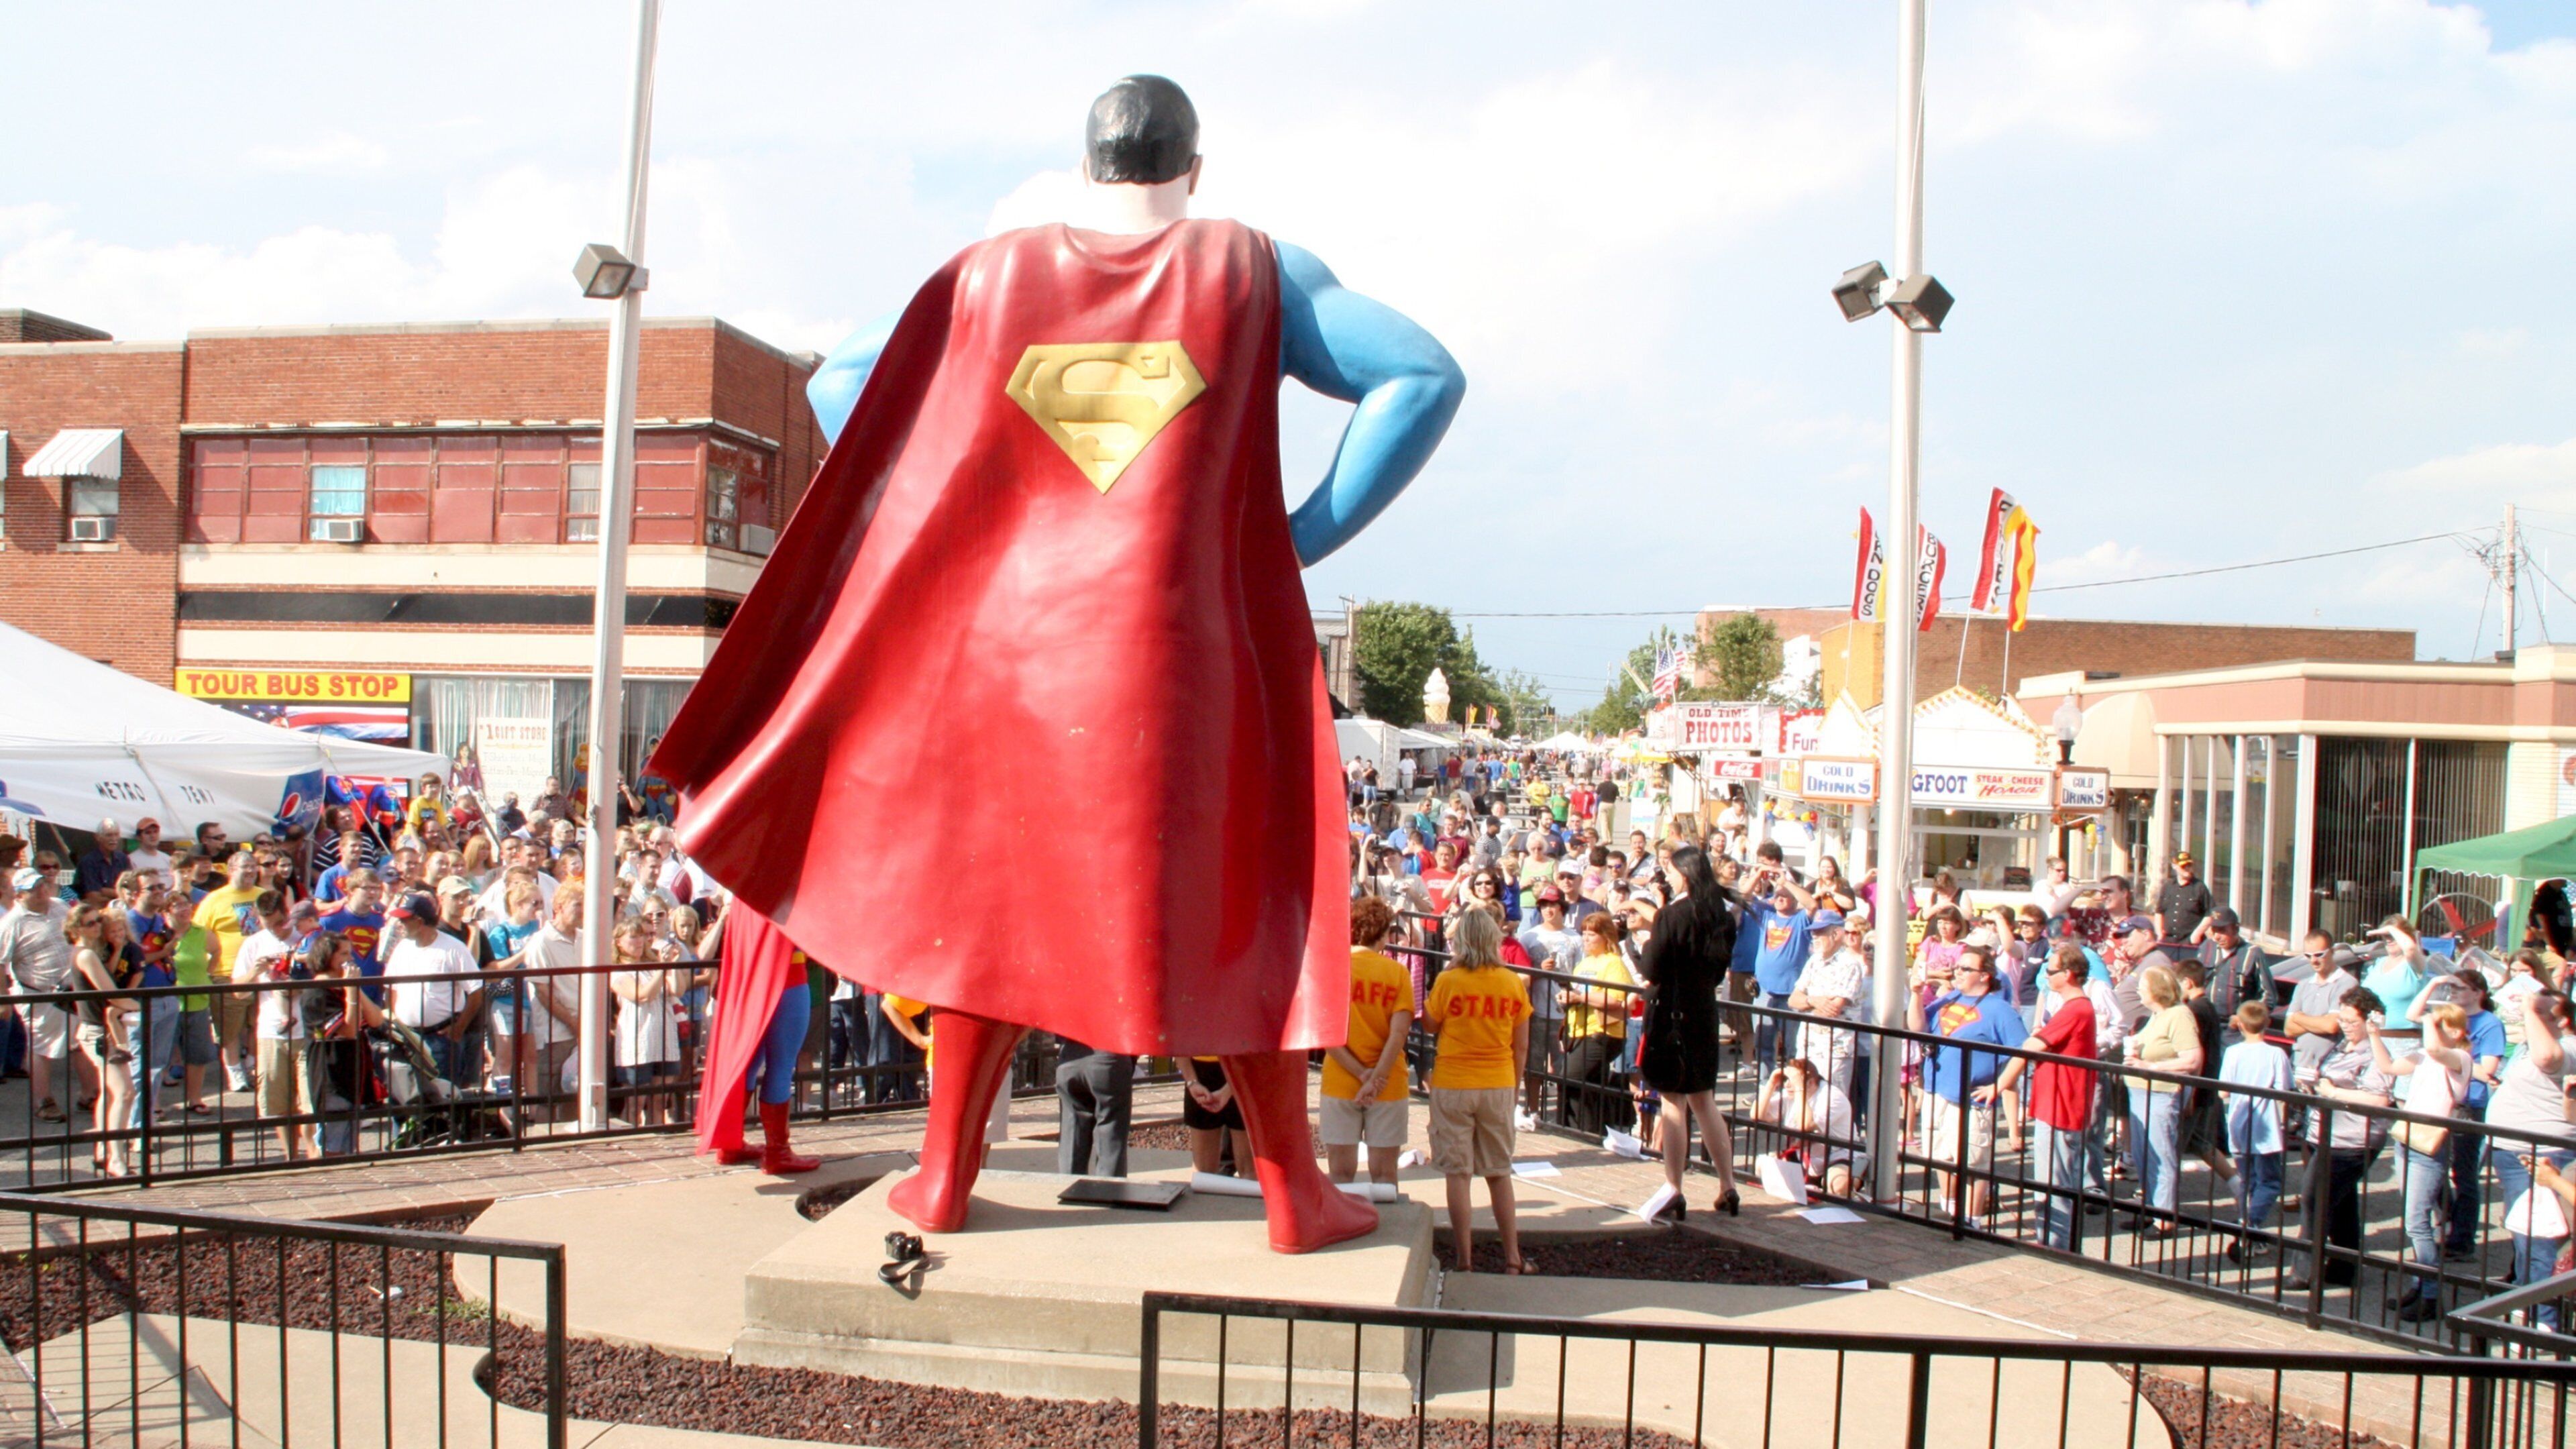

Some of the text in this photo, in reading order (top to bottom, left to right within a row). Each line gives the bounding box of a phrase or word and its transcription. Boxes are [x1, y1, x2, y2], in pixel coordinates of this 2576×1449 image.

[1917, 532, 1937, 623] BURGER
[1862, 569, 1880, 616] DOGS
[186, 674, 398, 697] TOUR BUS STOP
[1688, 708, 1711, 718] OLD
[1685, 721, 1752, 743] PHOTOS
[1823, 765, 1854, 777] COLD
[1976, 775, 2044, 786] STEAK CHEESE
[1807, 775, 1871, 795] DRINKS
[1912, 774, 1968, 794] GFOOT
[2072, 777, 2093, 788] COLD
[95, 782, 215, 805] METRO TENT
[2062, 790, 2104, 804] DRINKS
[1351, 980, 1398, 1008] AFF
[1450, 994, 1523, 1019] STAFF
